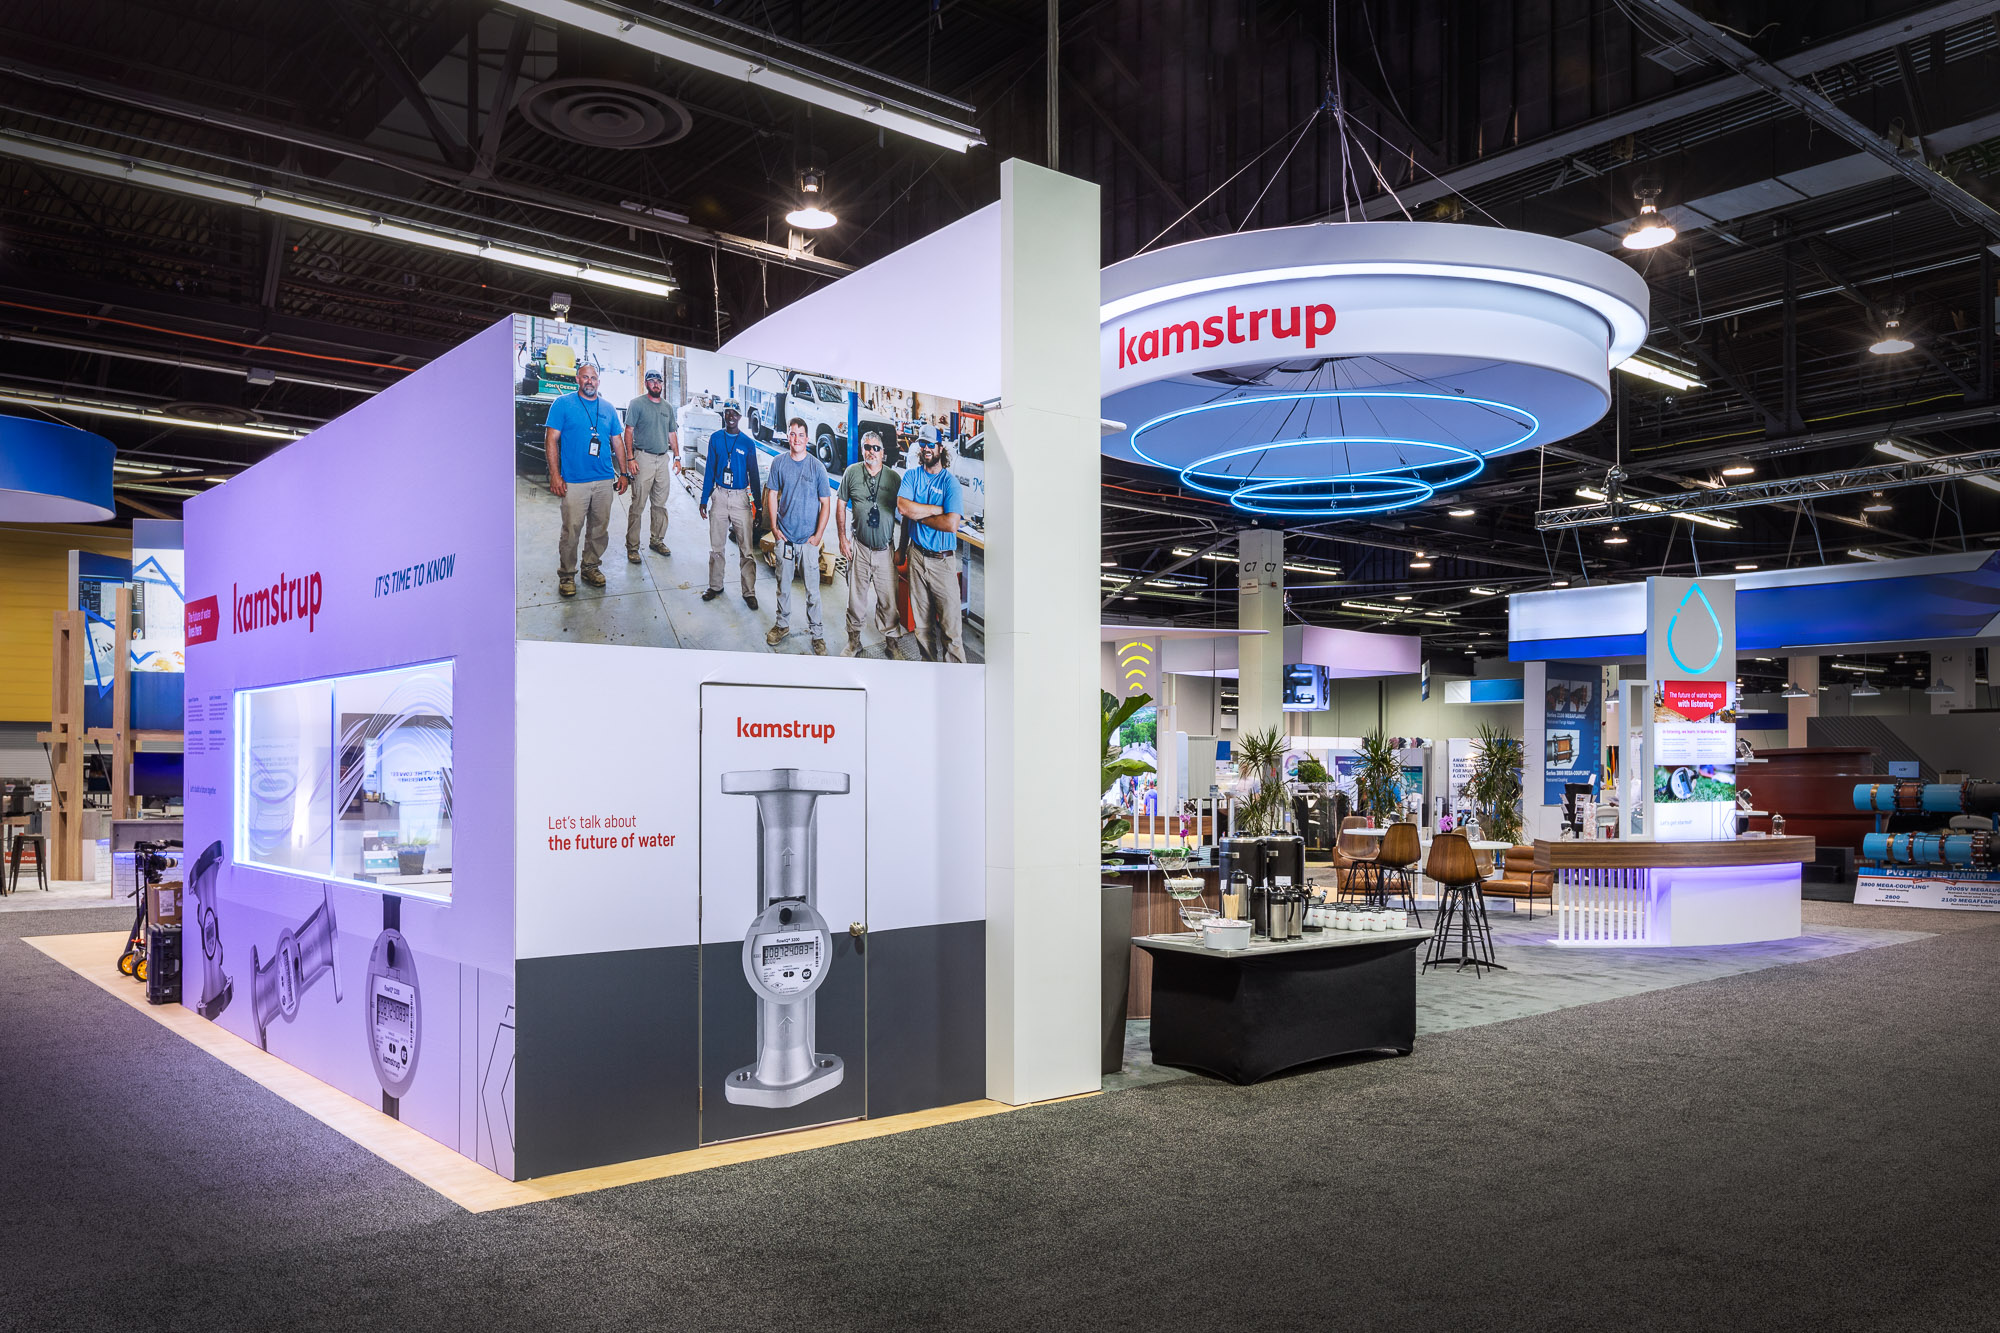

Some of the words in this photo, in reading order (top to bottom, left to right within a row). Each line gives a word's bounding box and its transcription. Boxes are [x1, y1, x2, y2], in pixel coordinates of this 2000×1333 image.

[1118, 303, 1337, 370] kamstrup
[560, 383, 577, 391] DEERE
[1244, 561, 1258, 573] C7
[1264, 562, 1277, 573] C7
[374, 573, 390, 598] IT'S
[392, 567, 412, 594] TIME
[413, 563, 425, 588] TO
[426, 553, 456, 585] KNOW
[233, 571, 322, 635] kamstrup
[1708, 692, 1722, 700] begins
[1691, 700, 1714, 710] listening
[737, 716, 836, 744] kamstrup
[548, 816, 576, 830] Let's
[580, 815, 601, 829] talk
[604, 814, 637, 828] about
[548, 835, 571, 851] the
[575, 833, 617, 850] future
[621, 832, 635, 848] of
[638, 832, 676, 848] water
[1886, 869, 1906, 877] PVC
[1906, 870, 1928, 878] PIPE
[1930, 871, 1988, 880] RESTRAINTS
